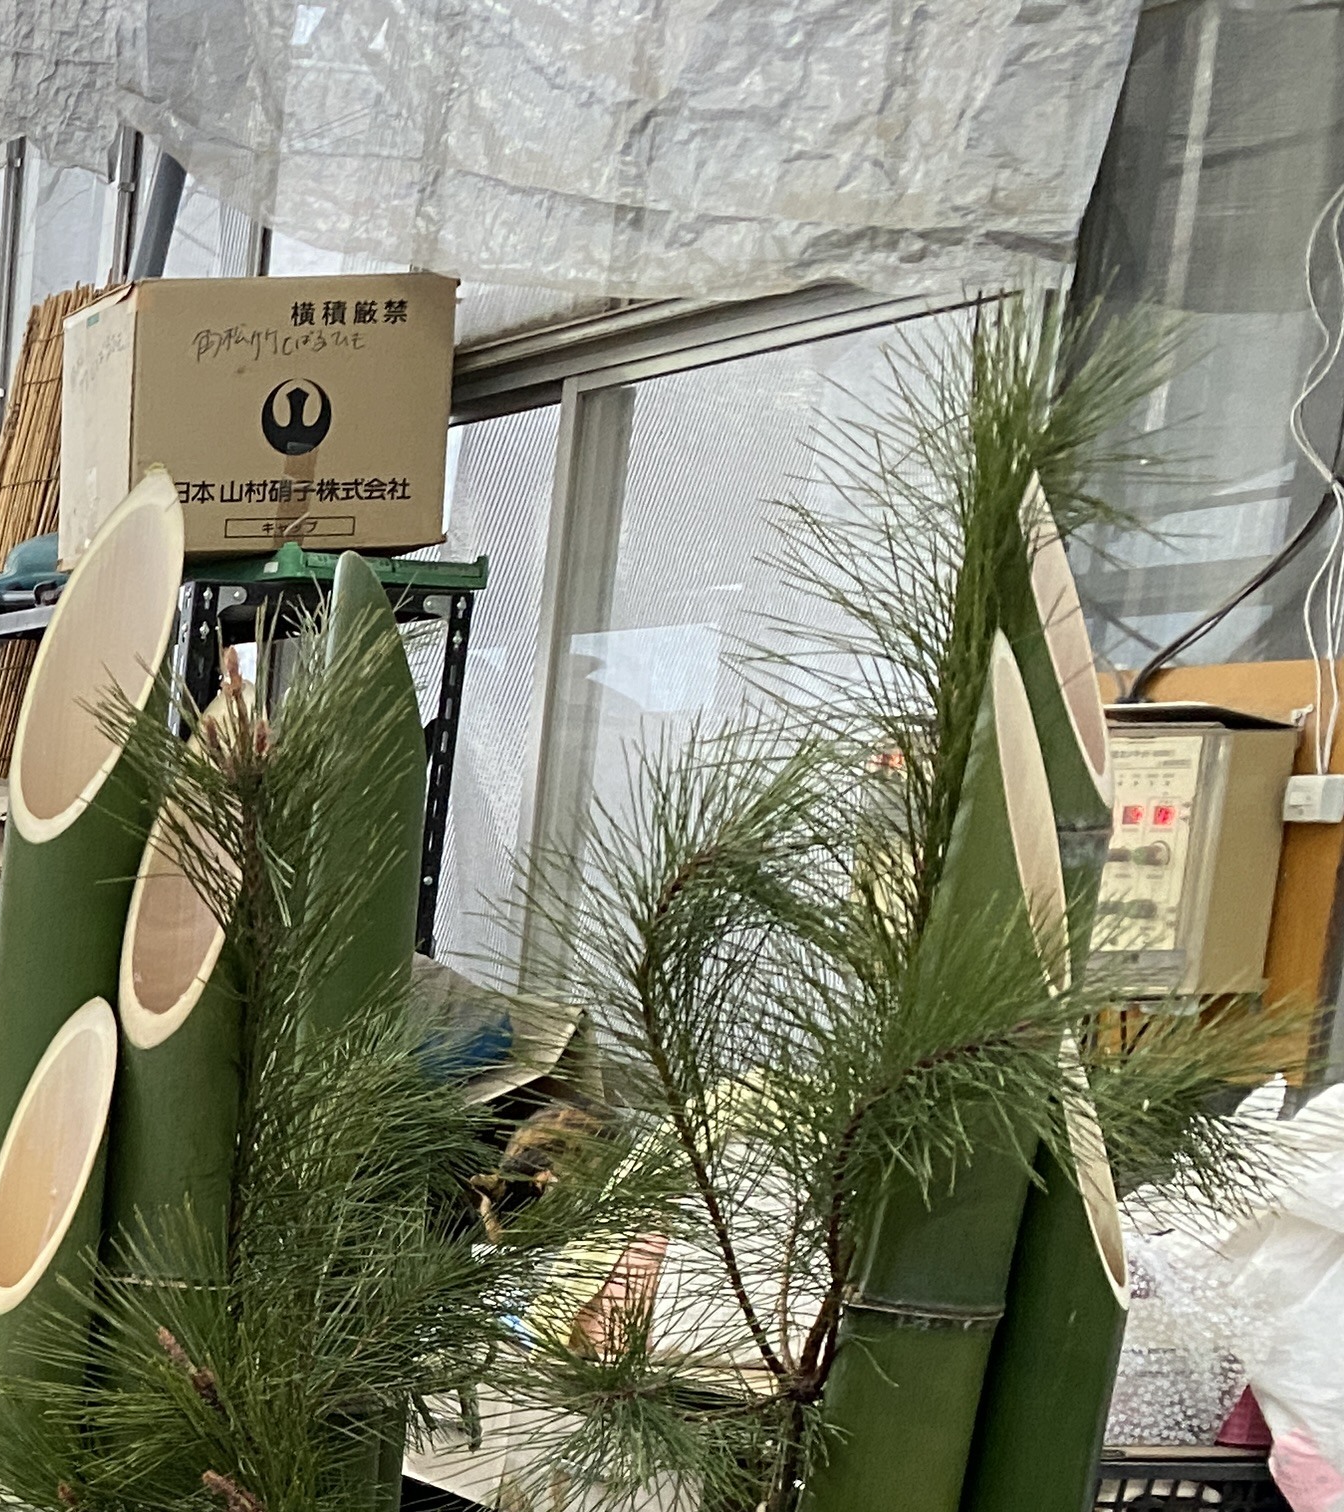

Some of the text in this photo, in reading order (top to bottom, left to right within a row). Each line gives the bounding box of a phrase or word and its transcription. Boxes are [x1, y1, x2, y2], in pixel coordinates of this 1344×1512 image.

[291, 299, 408, 327] 横積厳禁
[174, 477, 411, 504] 日本山村硝子株式会社
